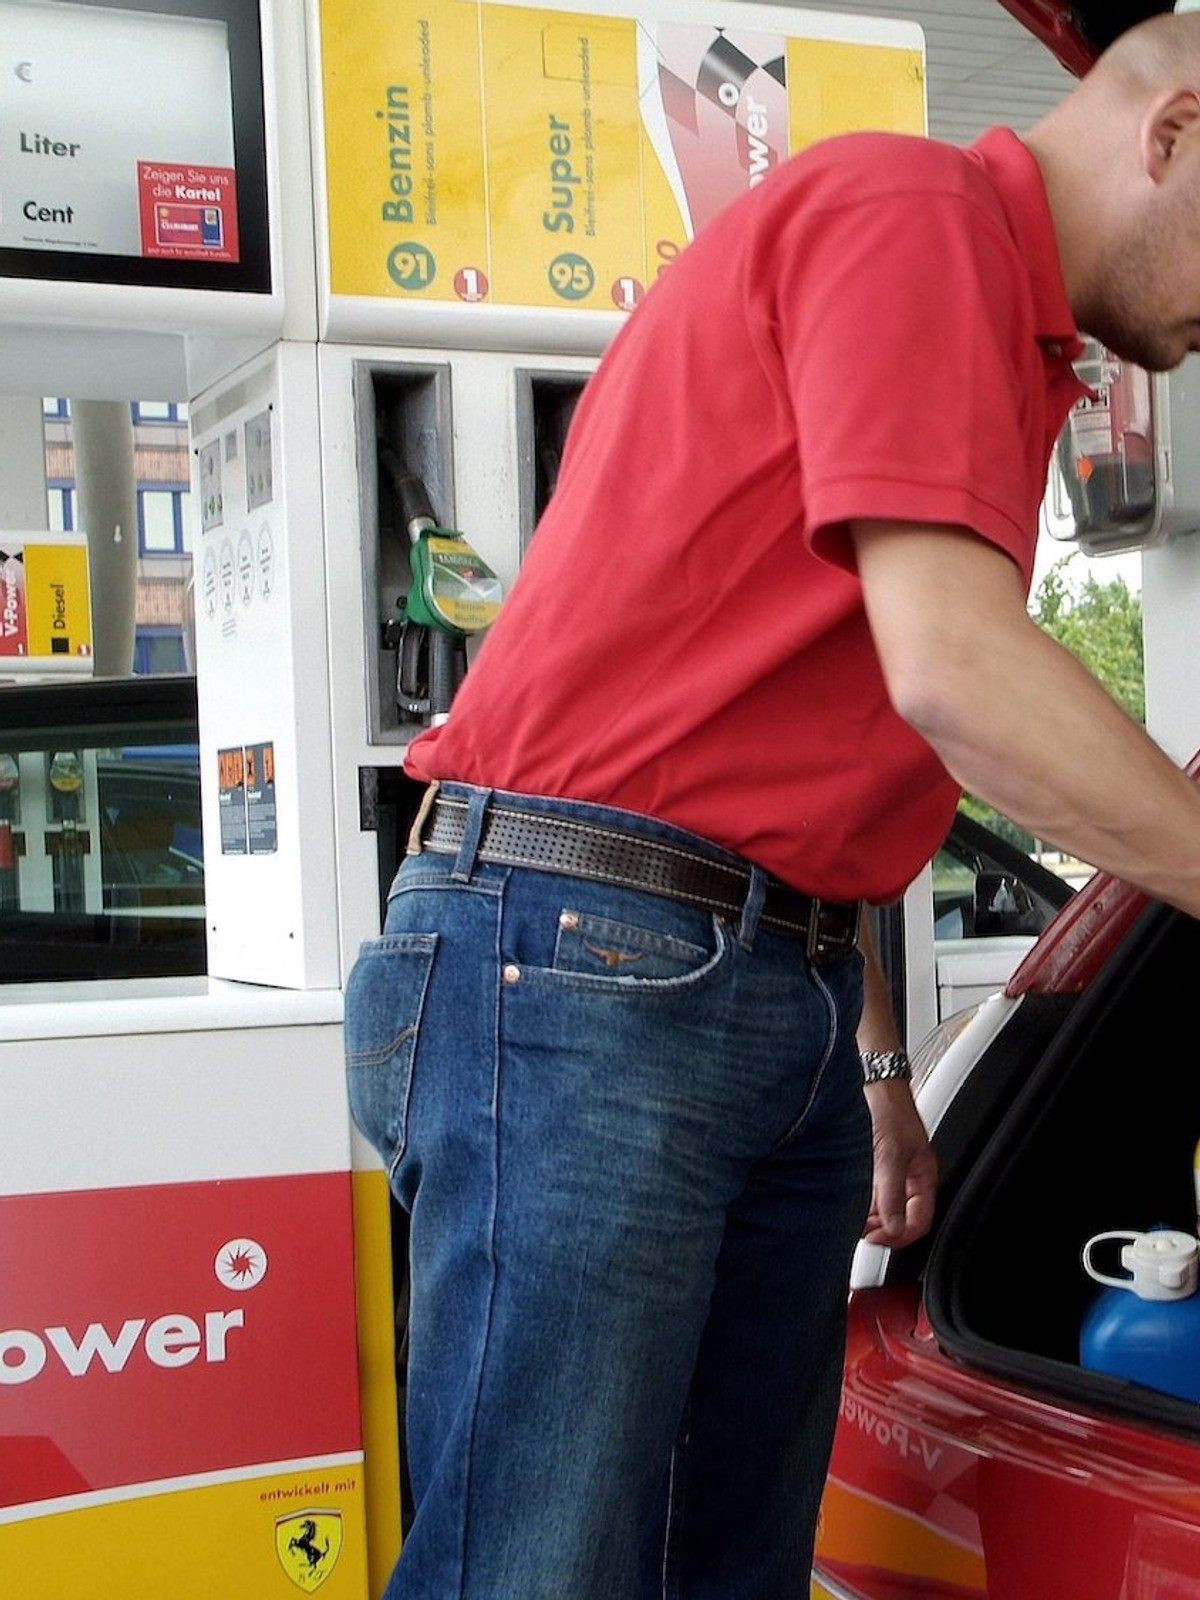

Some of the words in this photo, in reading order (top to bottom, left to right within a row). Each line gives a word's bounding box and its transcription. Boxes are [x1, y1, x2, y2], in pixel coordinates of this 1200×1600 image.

[417, 19, 431, 85] unleaded
[14, 62, 32, 83] €
[577, 36, 591, 100] unleaded
[421, 92, 435, 137] plomb
[20, 132, 81, 157] Liter
[375, 85, 413, 224] Benzin
[143, 166, 185, 184] Zeigen
[187, 169, 207, 184] Sie
[209, 175, 229, 186] uns
[542, 114, 581, 235] Super
[152, 184, 172, 198] die
[23, 201, 75, 224] Cent
[394, 251, 429, 281] 91
[551, 262, 590, 292] 95
[462, 269, 482, 301] 1
[619, 279, 638, 309] 1
[50, 583, 66, 630] Diesel
[259, 1481, 330, 1501] entwickelt
[335, 1479, 356, 1492] mit
